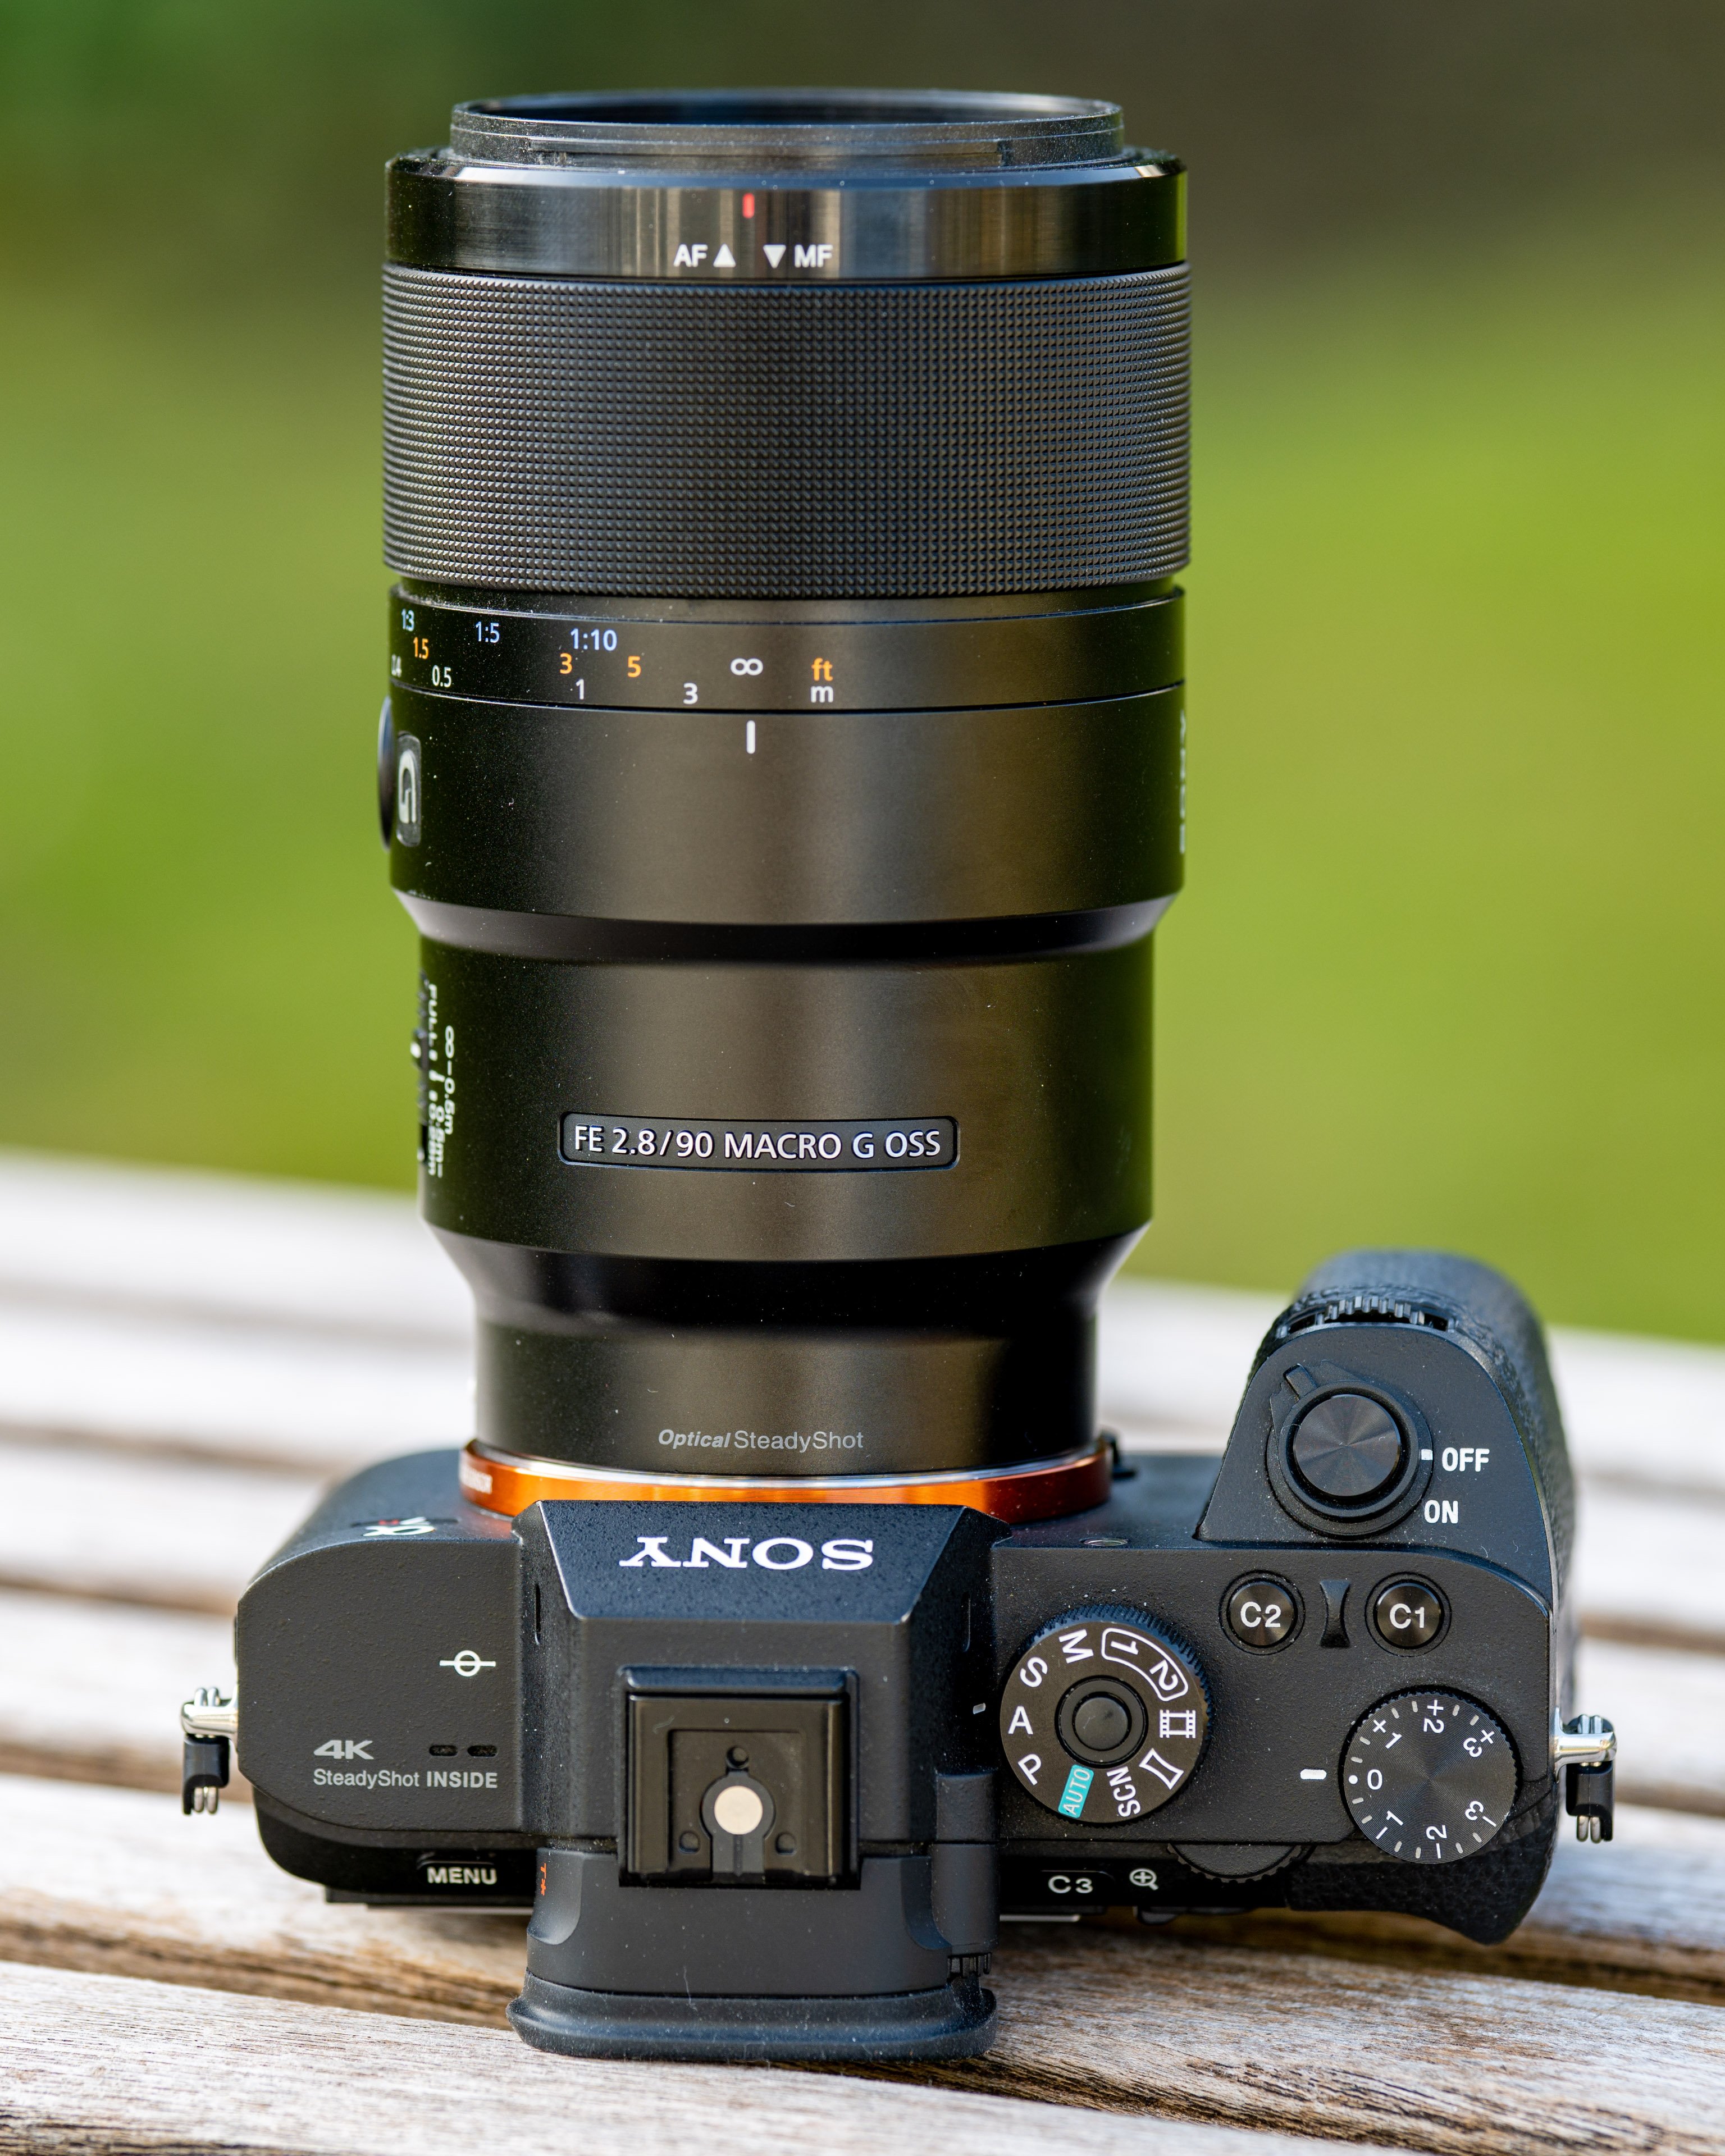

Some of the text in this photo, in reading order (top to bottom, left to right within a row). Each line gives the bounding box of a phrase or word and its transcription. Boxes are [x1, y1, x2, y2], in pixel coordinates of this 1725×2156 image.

[673, 244, 835, 267] AF MF
[401, 608, 617, 651] 1:3 1:5 1:10
[413, 637, 833, 682] 1.5 3 5 ft
[432, 665, 451, 688] 0.5
[576, 679, 585, 700] 1
[683, 683, 698, 705] 3
[811, 686, 834, 703] m
[429, 984, 438, 1047] FULL
[575, 1124, 941, 1159] FE 2.8/90 MACRO G OSS
[658, 1429, 864, 1453] Optical SteadyShot
[1441, 1447, 1490, 1472] OFF
[1424, 1500, 1458, 1524] ON
[618, 1536, 873, 1571] SONY
[1240, 1601, 1281, 1628] C2
[1389, 1603, 1425, 1629] C1
[1058, 1629, 1094, 1664] M
[1110, 1639, 1139, 1656] 1
[1020, 1657, 1048, 1688] S
[1149, 1659, 1179, 1691] 2
[1008, 1706, 1033, 1735] A
[313, 1739, 374, 1760] 4K
[313, 1768, 498, 1789] SteadyShot INSIDE
[1017, 1753, 1042, 1785] P
[1367, 1769, 1382, 1790] 0
[1062, 1767, 1092, 1815] AUTO
[1107, 1766, 1142, 1817] SCN
[427, 1867, 497, 1885] MENU
[1048, 1875, 1093, 1894] C3
